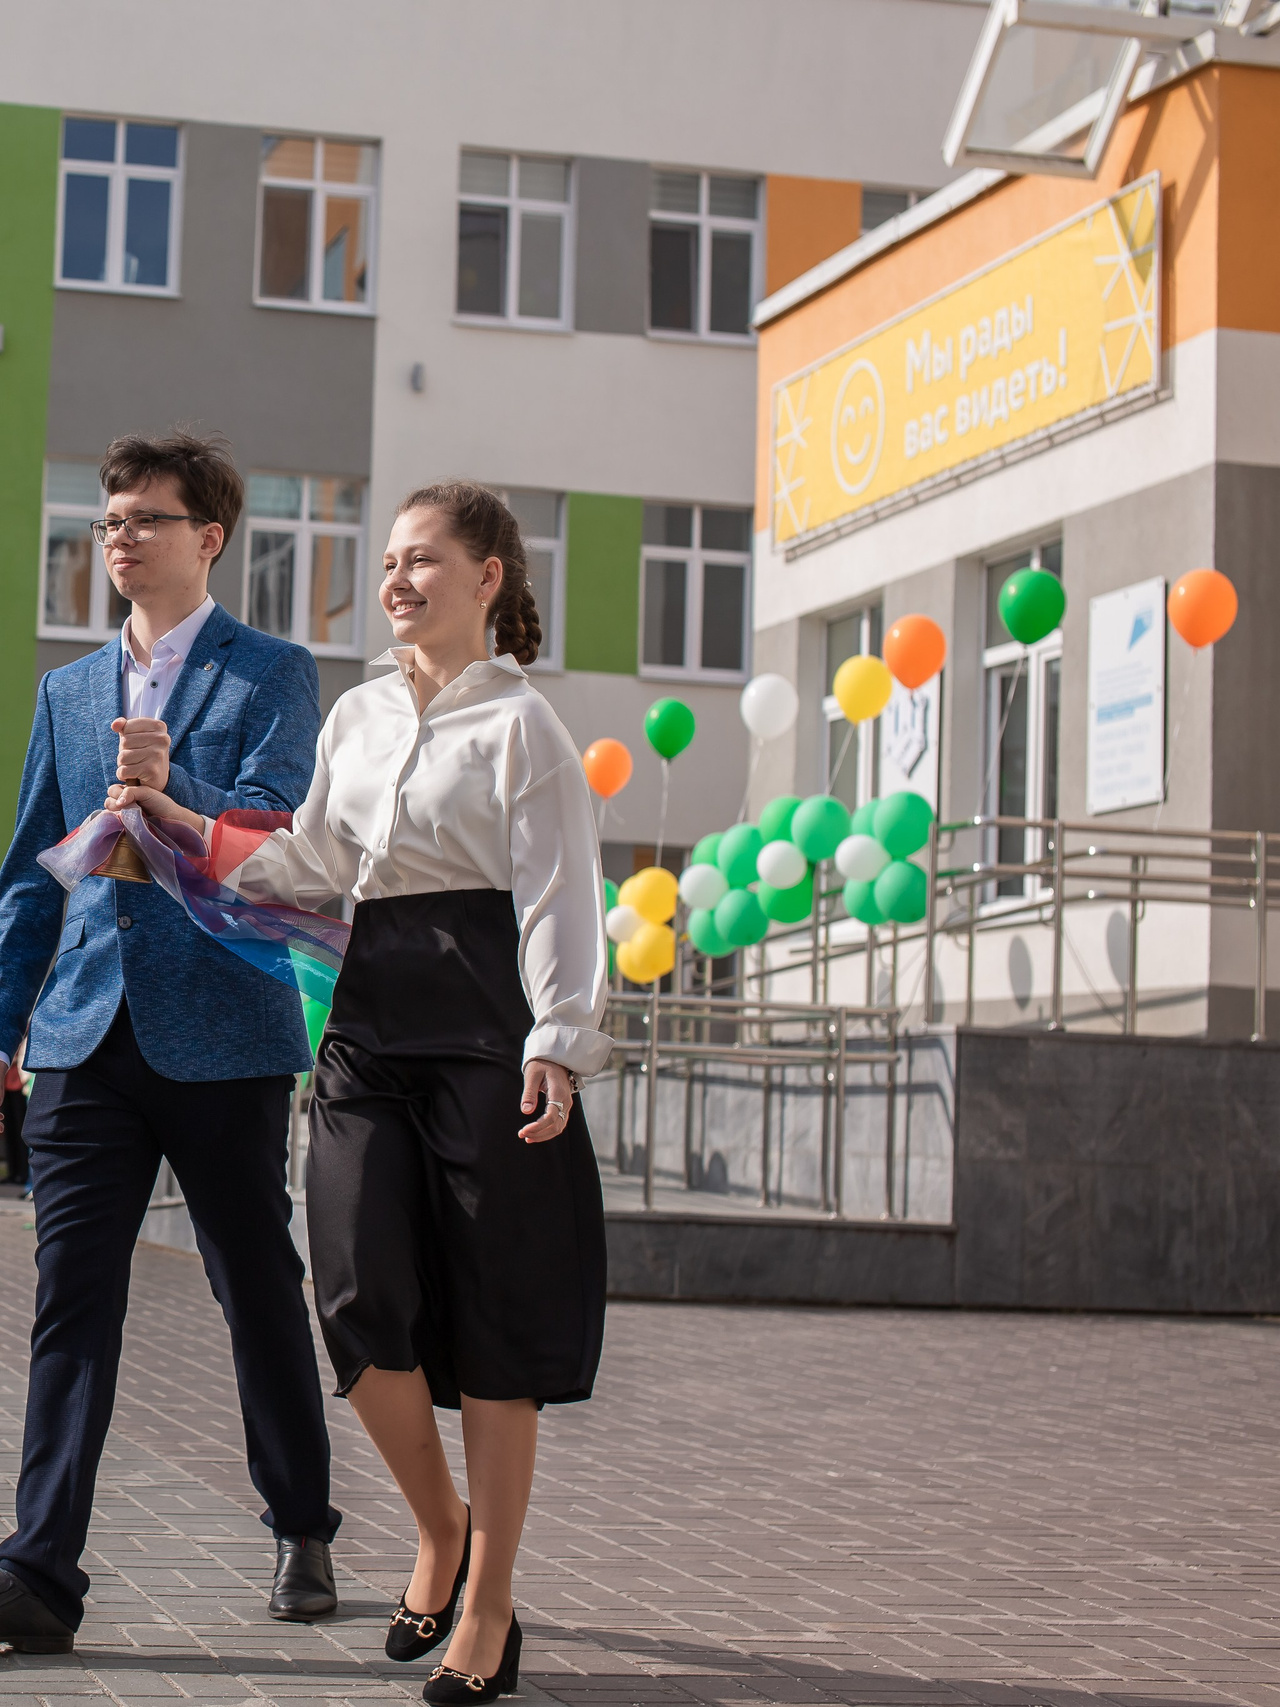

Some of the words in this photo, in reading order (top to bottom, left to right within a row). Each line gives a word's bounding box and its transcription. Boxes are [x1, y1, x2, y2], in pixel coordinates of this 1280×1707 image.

[905, 405, 949, 459] вас
[956, 329, 1067, 435] видеть!
[906, 329, 953, 393] Мы
[959, 293, 1033, 382] рады
